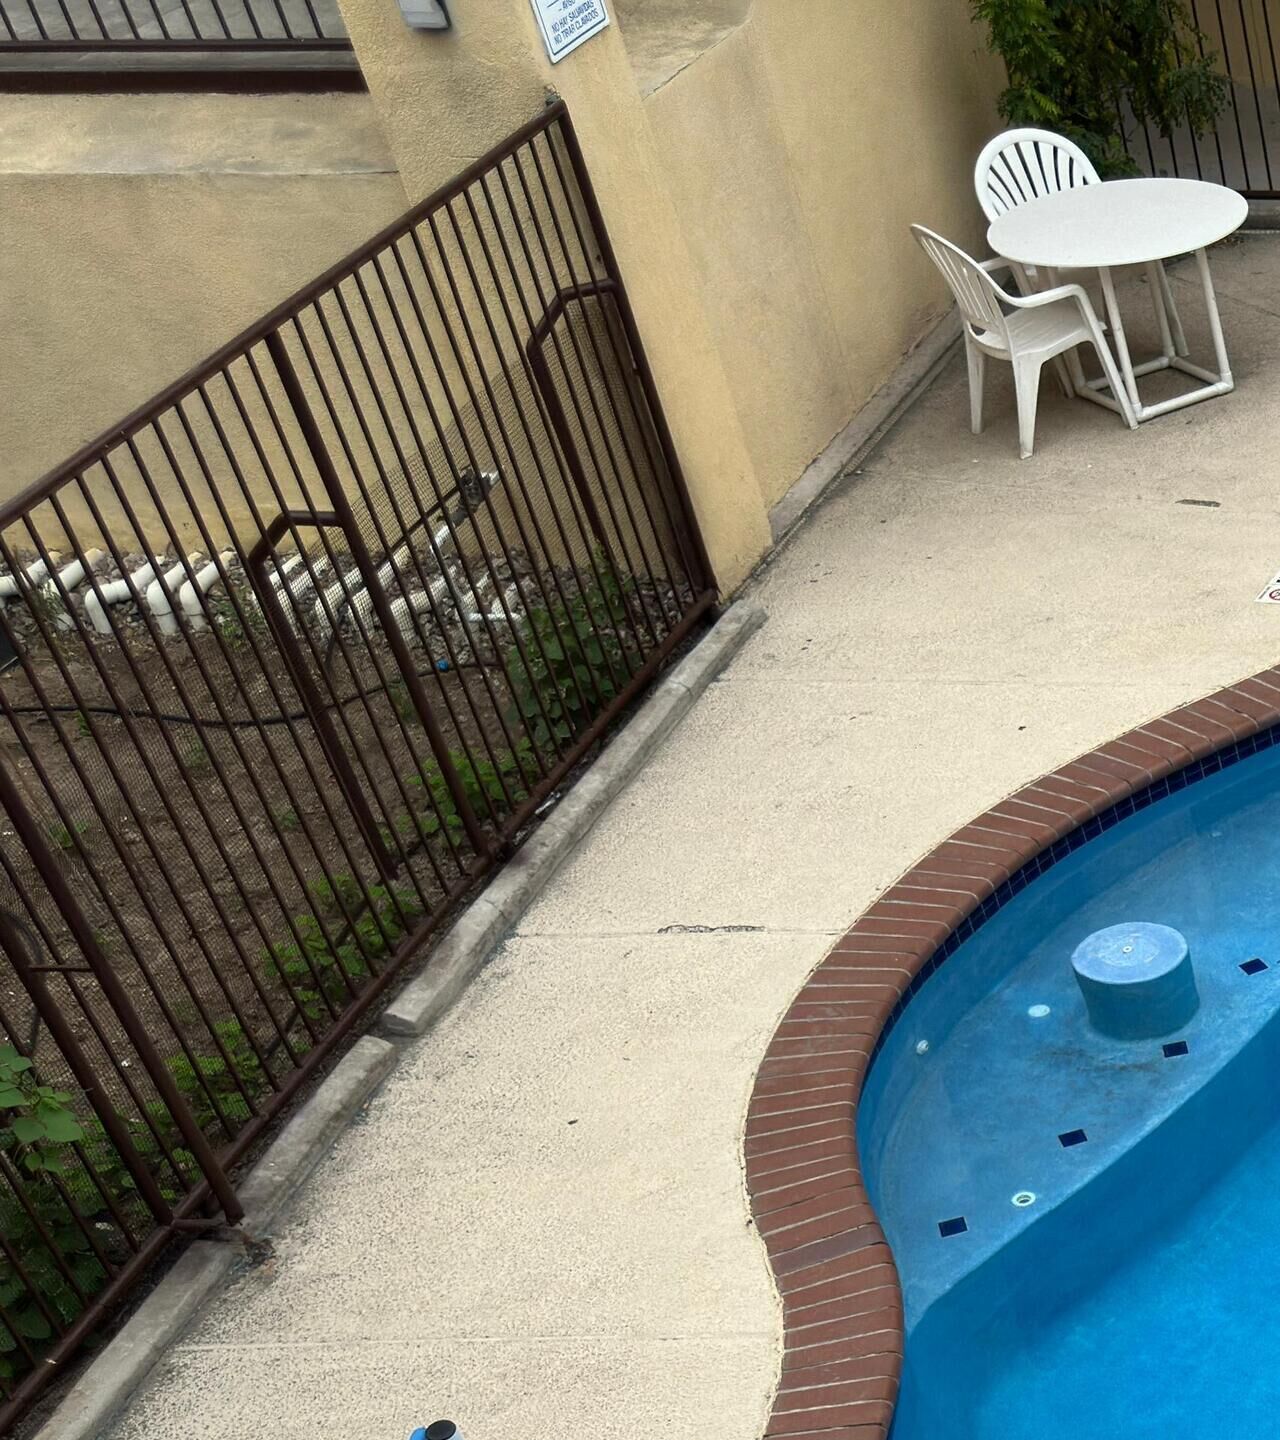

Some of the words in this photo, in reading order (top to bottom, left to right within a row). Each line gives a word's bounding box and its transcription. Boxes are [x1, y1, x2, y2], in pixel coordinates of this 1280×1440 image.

[551, 22, 560, 33] NO
[559, 16, 568, 28] HAY
[554, 34, 562, 45] NO
[562, 24, 576, 39] TIRAR
[575, 8, 599, 29] CLAVADOS
